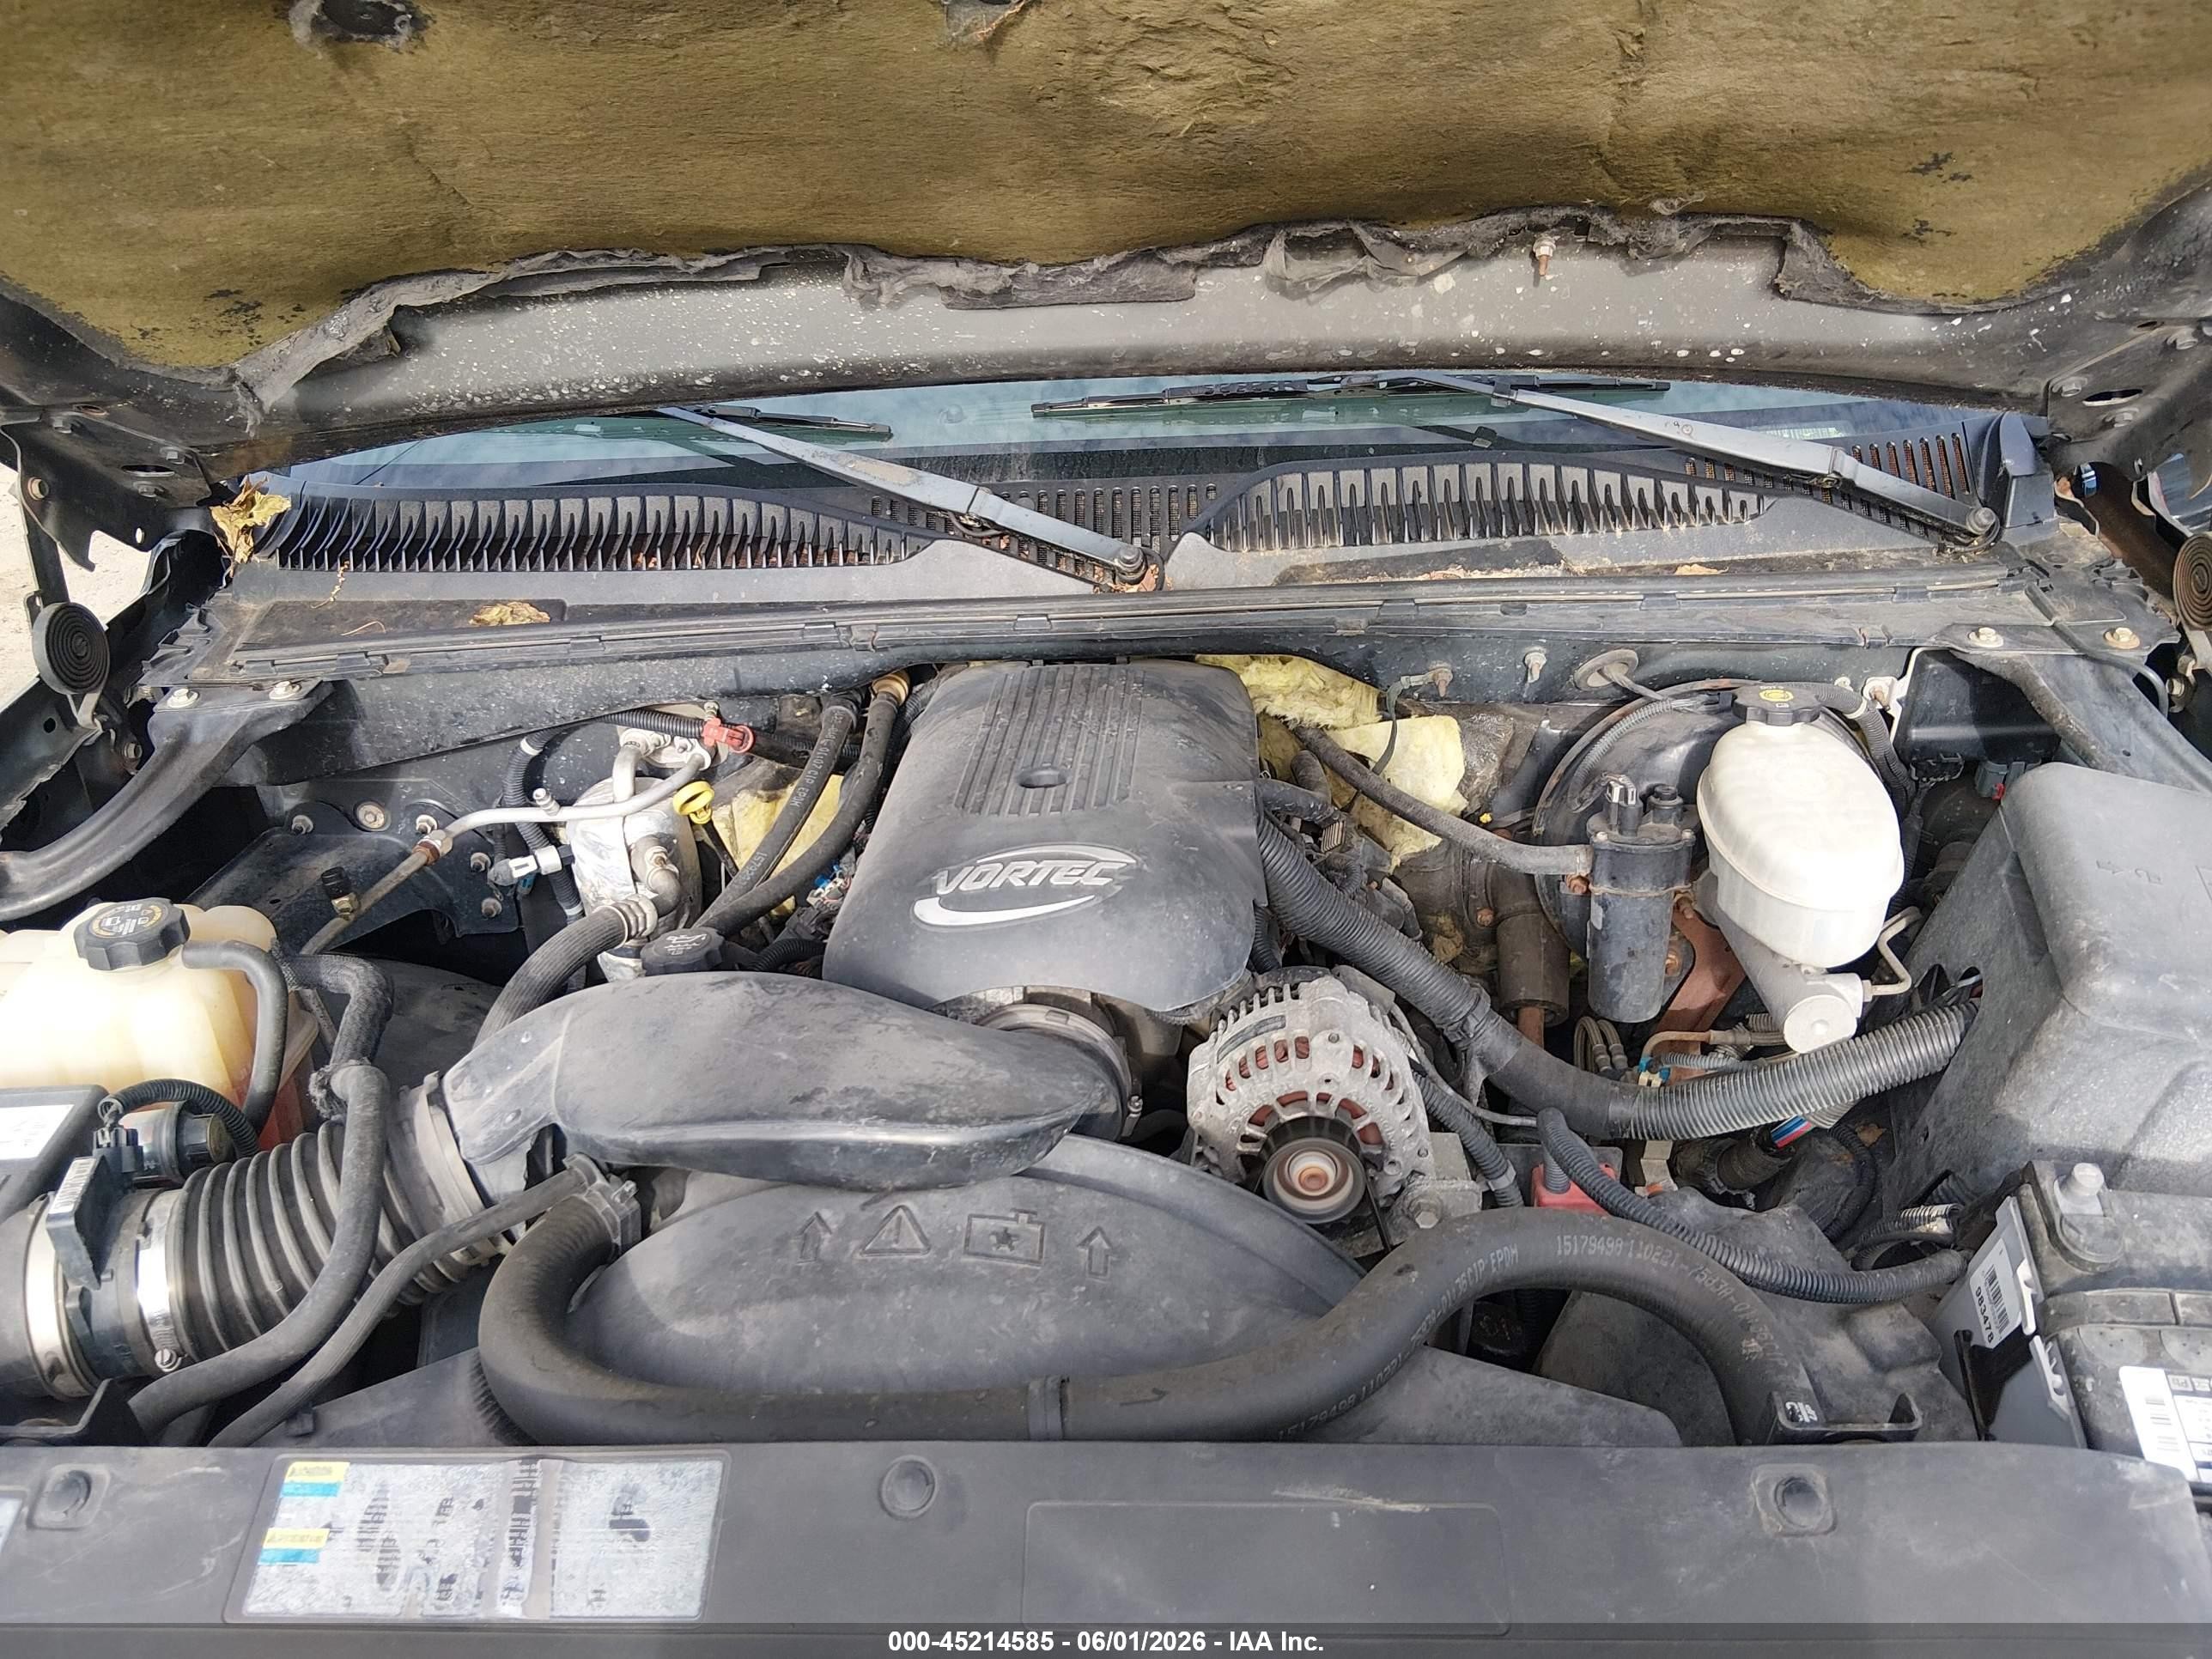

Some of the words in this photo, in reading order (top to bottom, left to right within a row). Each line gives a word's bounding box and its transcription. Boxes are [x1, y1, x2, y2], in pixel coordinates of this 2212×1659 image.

[936, 859, 1127, 895] VORTEC
[1489, 1244, 1519, 1273] EPDM
[1556, 1235, 1623, 1257] 15179498
[1975, 1286, 1994, 1344] 983478
